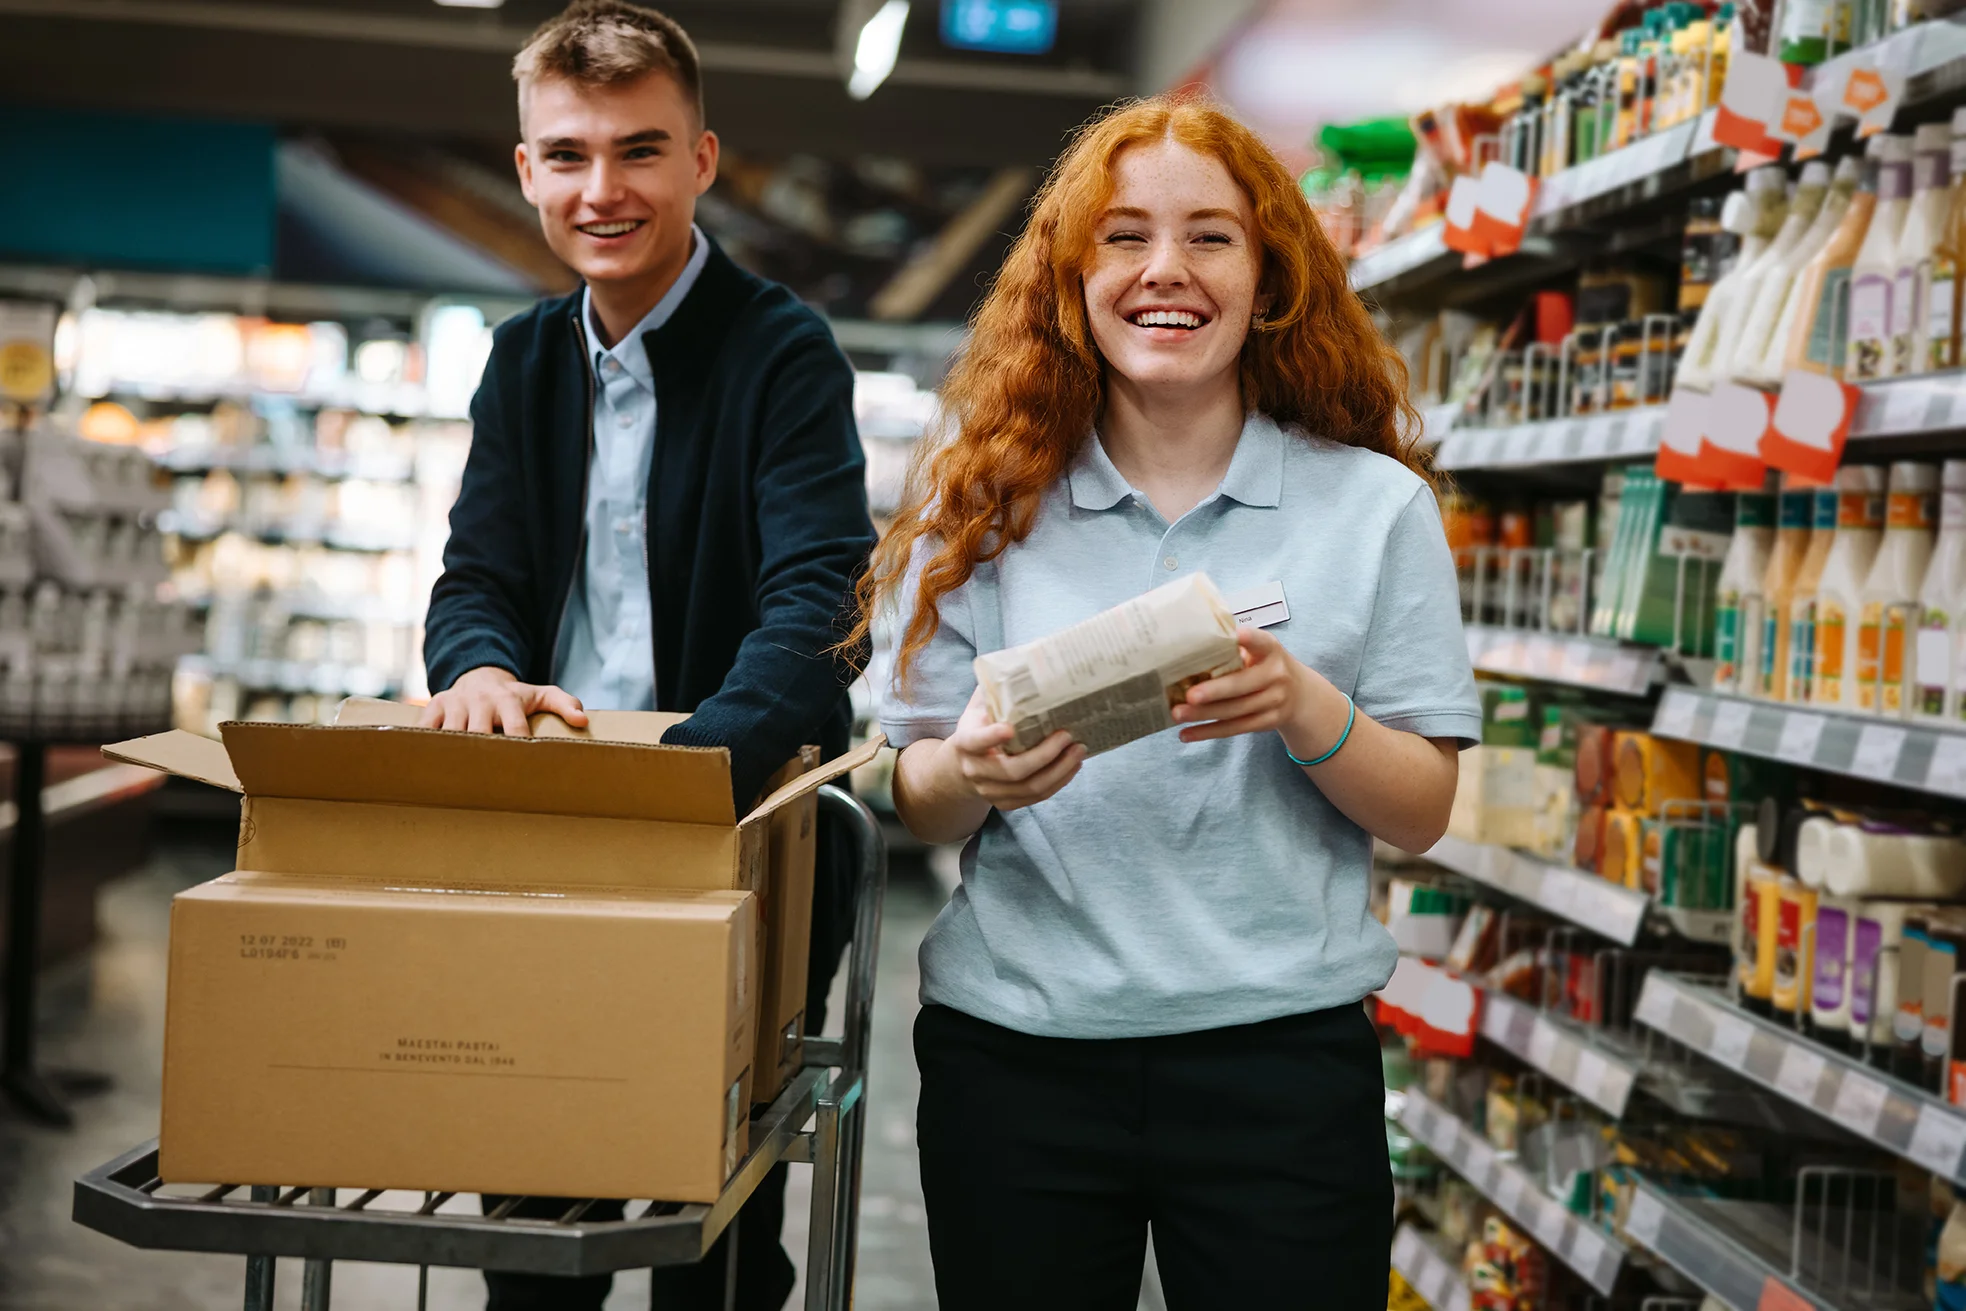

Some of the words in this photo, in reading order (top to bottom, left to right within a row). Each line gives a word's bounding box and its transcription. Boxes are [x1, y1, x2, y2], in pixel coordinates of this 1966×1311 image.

[1239, 616, 1252, 624] Nina
[240, 934, 256, 945] 12
[259, 935, 276, 946] 07
[282, 935, 314, 947] 2022
[397, 1038, 453, 1049] MAESTRI
[457, 1040, 500, 1051] PASTAI
[378, 1053, 392, 1062] IN
[395, 1053, 462, 1064] BENEVENTO
[464, 1055, 486, 1066] DAL
